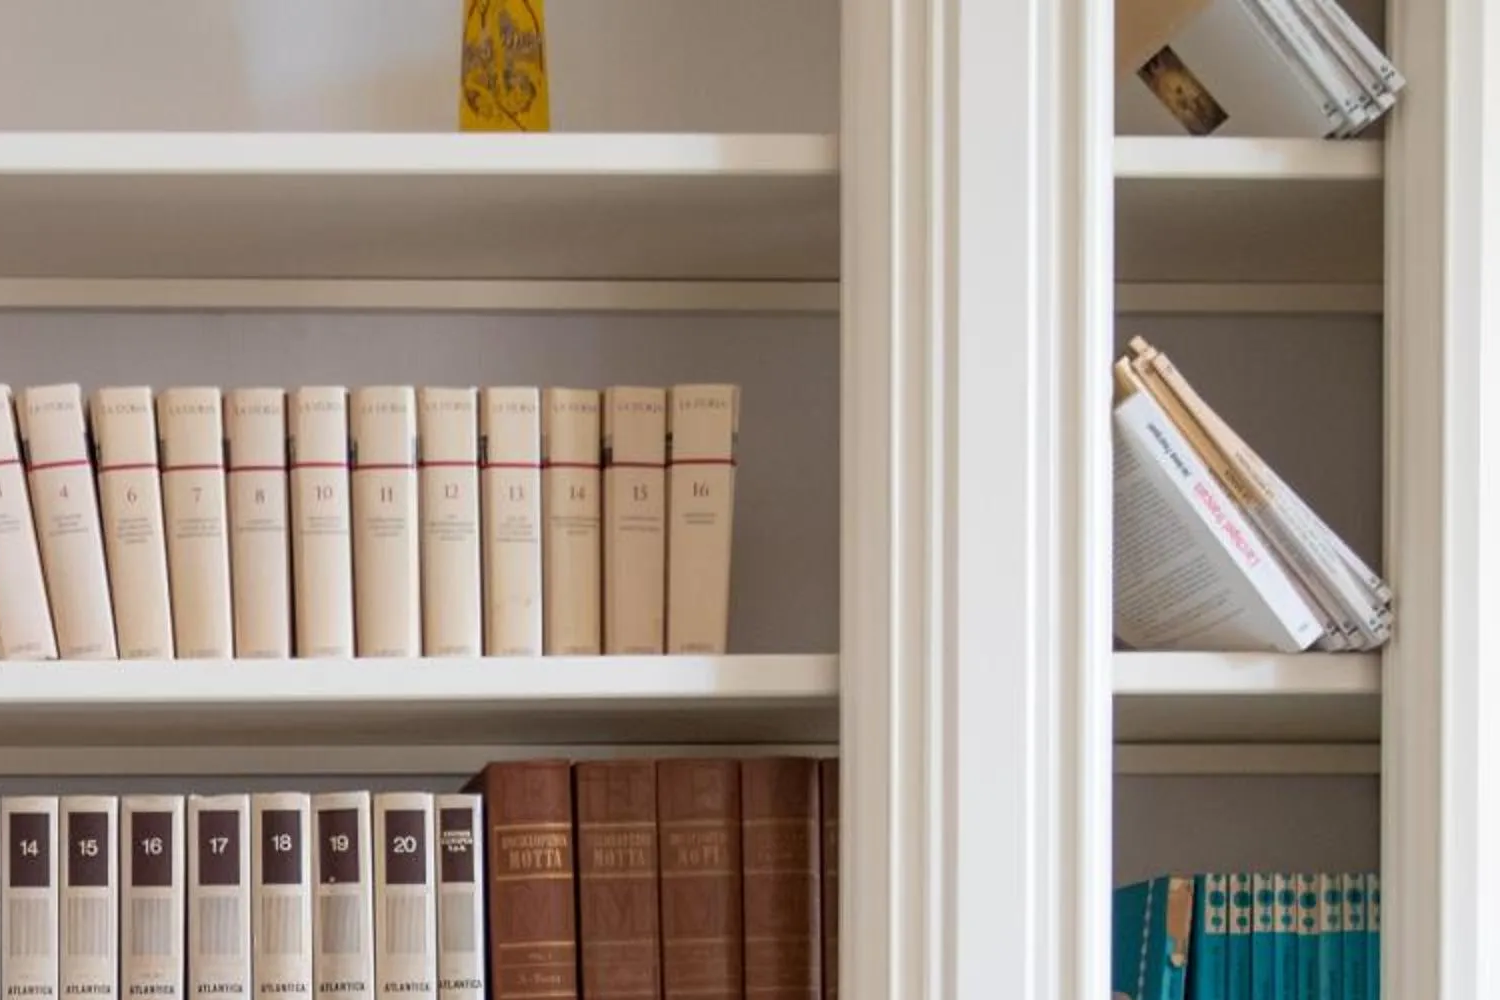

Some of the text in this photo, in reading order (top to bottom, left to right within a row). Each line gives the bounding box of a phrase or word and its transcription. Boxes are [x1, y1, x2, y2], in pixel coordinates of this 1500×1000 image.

[127, 489, 136, 501] 6
[317, 486, 332, 501] 10
[381, 487, 392, 502] 11
[445, 485, 458, 498] 12
[509, 486, 523, 501] 13
[570, 487, 585, 499] 14
[633, 486, 647, 501] 15
[693, 482, 709, 497] 16
[20, 840, 38, 855] 14
[78, 840, 97, 856] 15
[143, 838, 162, 854] 16
[209, 838, 228, 853] 17
[271, 835, 291, 851] 18
[329, 836, 348, 851] 19
[393, 837, 416, 853] 20
[509, 848, 562, 870] MOTTA
